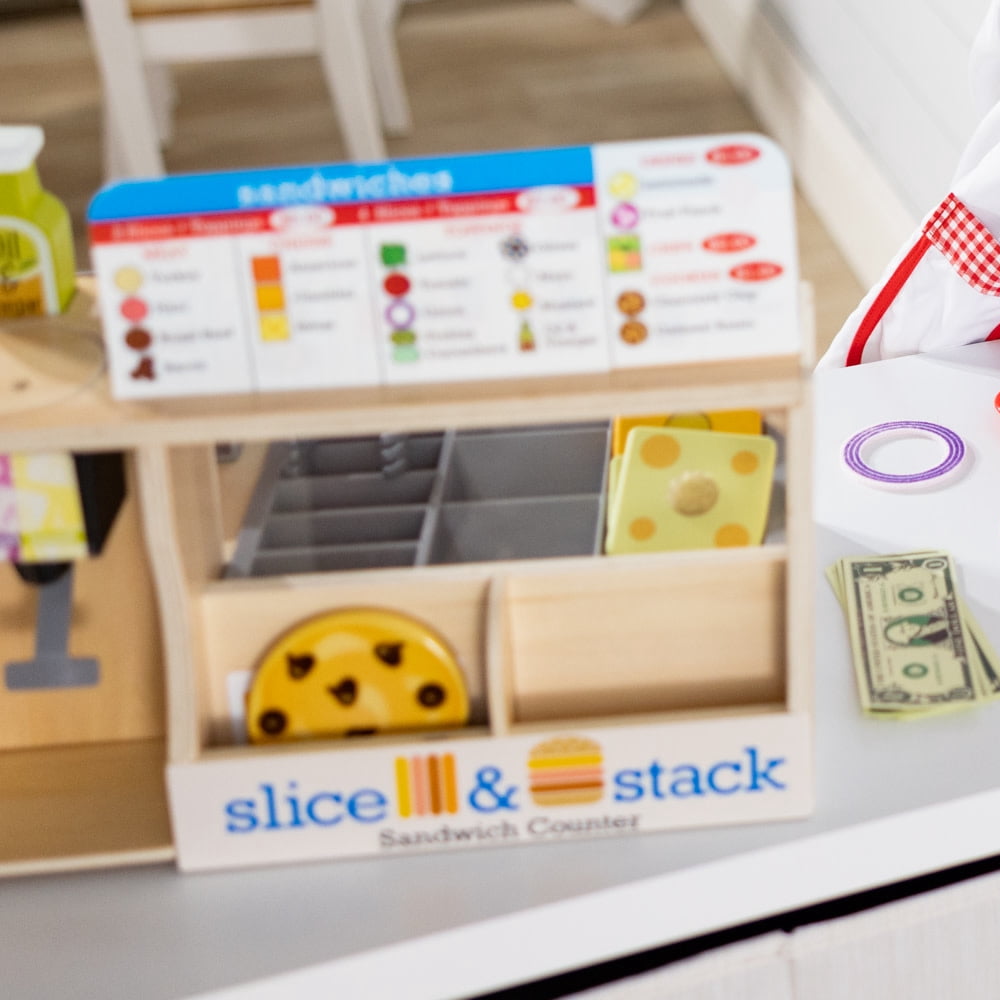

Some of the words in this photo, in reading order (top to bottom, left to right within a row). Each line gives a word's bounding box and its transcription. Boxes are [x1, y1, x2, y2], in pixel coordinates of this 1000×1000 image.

[237, 166, 453, 208] sandwiches
[224, 780, 389, 834] slice
[468, 765, 520, 813] &
[612, 747, 788, 803] stack
[379, 817, 521, 848] Sandwich
[527, 812, 642, 838] Counter
